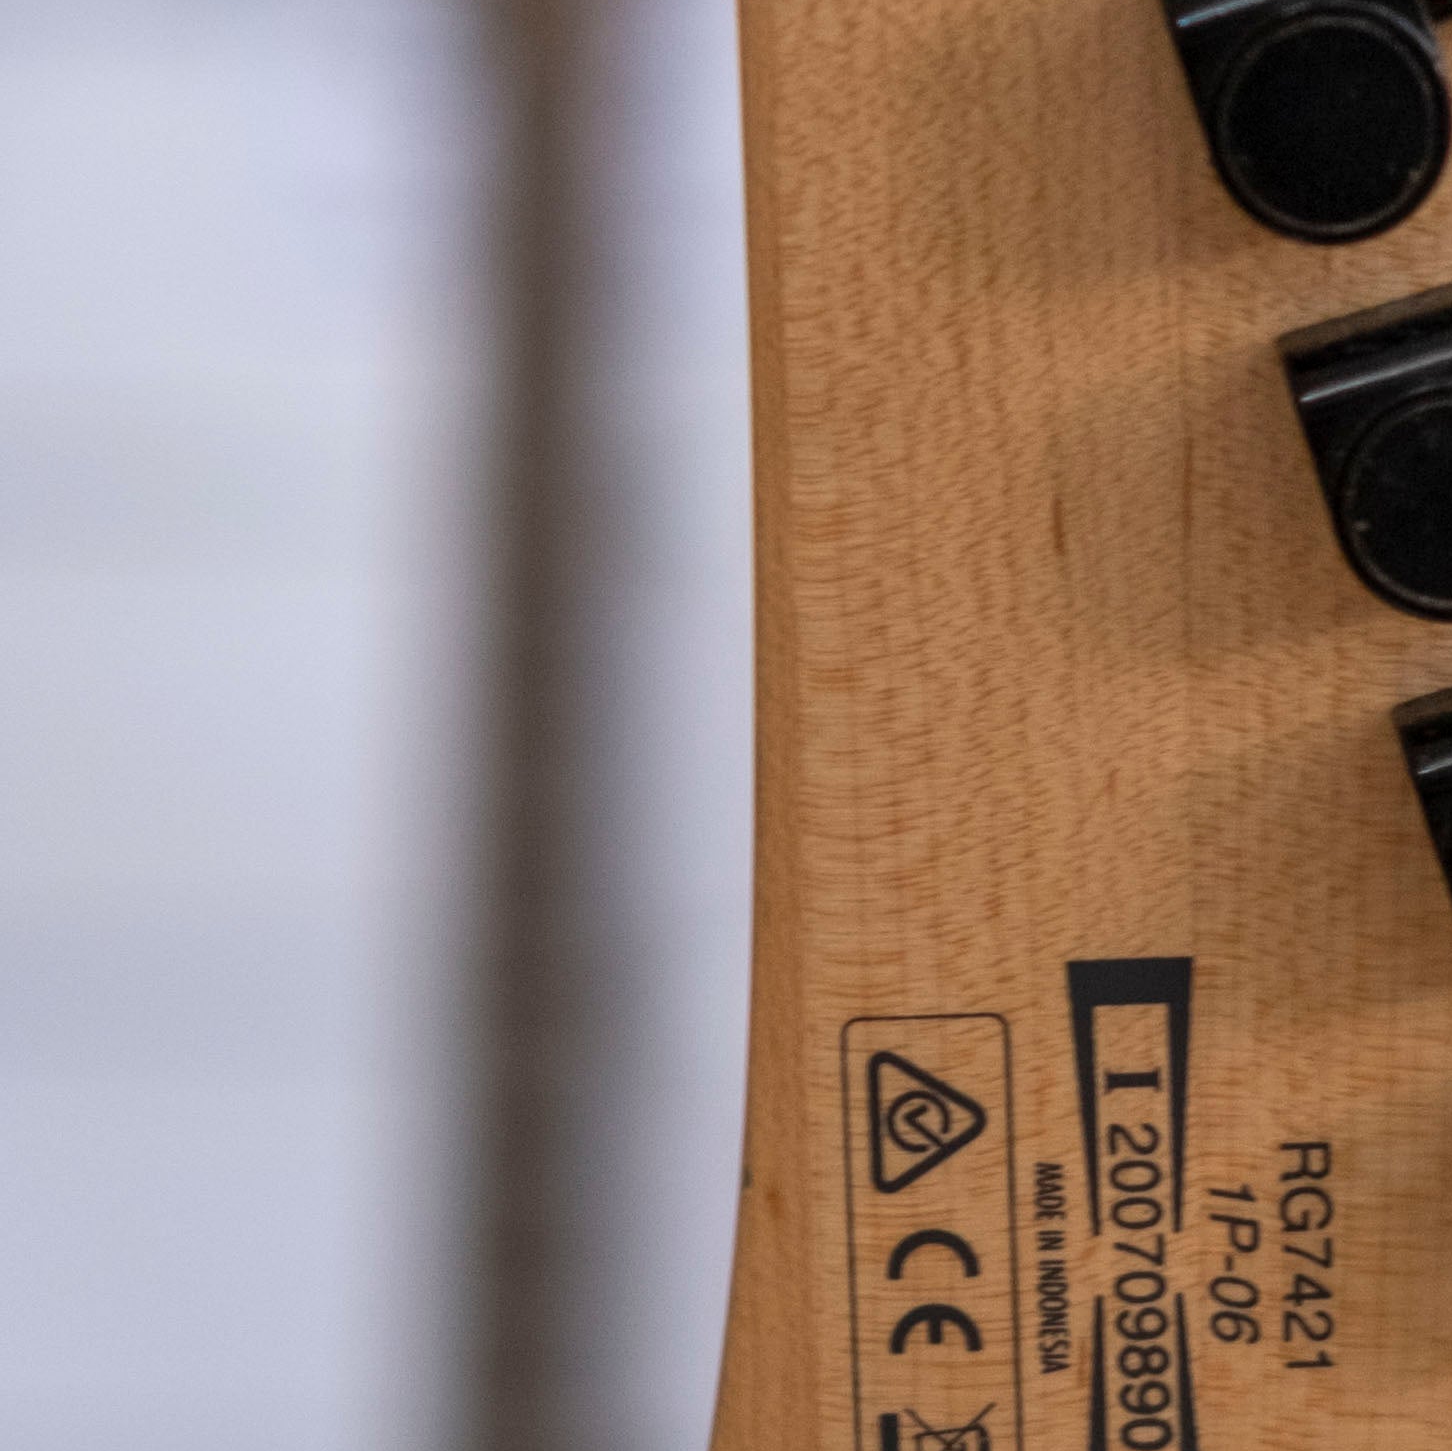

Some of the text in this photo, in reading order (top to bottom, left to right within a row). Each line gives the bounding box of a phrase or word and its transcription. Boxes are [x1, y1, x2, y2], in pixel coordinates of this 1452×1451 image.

[1032, 1160, 1072, 1376] MADE IN INDONESIA
[1278, 1139, 1336, 1370] RG7421
